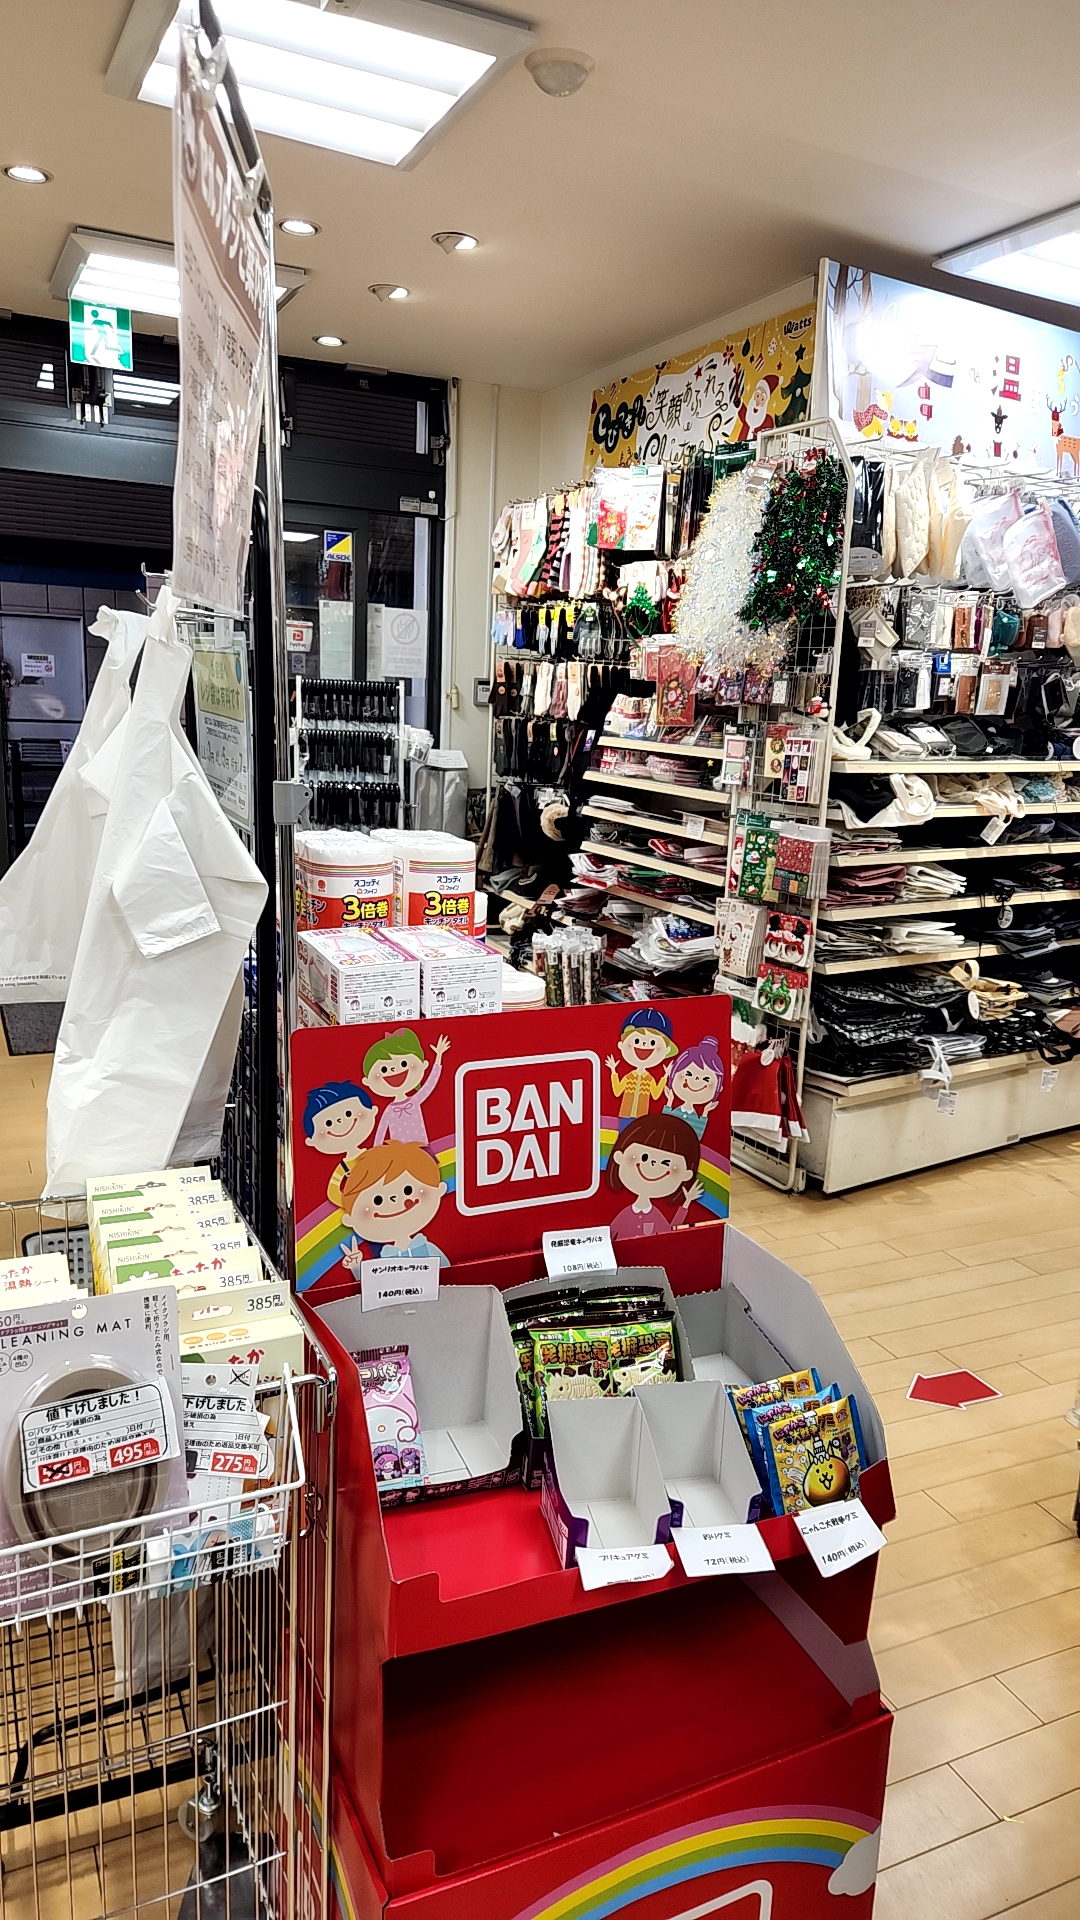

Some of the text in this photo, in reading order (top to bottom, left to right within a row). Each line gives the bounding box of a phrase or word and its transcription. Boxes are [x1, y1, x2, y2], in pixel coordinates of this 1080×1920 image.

[784, 317, 813, 336] Watts
[655, 374, 725, 428] 笑顔あふれる
[200, 683, 240, 711] レジ袋は有料です
[353, 879, 380, 888] スコッティ
[436, 876, 462, 884] スコッティ
[342, 895, 389, 921] 3倍巻
[424, 891, 470, 916] 3倍巻
[424, 916, 469, 926] キッチンタオル
[476, 1079, 583, 1136] BAN
[476, 1131, 560, 1187] DAI
[94, 1184, 123, 1193] NISHIKIN
[101, 1206, 131, 1215] NISHIKIN
[108, 1230, 139, 1239] NISHIKIN
[117, 1254, 150, 1263] NISHIKIN
[561, 1261, 603, 1273] 108円(税込)
[371, 1264, 430, 1275] サンリオキャラパキ
[4, 1278, 59, 1291] 温熱シート
[378, 1287, 423, 1299] 140円(税込)
[247, 1294, 281, 1311] 385円
[1, 1318, 132, 1350] LEANING MAT
[152, 1295, 163, 1375] 軽くて折りたたみ式なので
[540, 1341, 608, 1365] 発掘恐竜
[737, 1383, 770, 1406] にゃんこ
[46, 1391, 140, 1422] 値下げしました！
[757, 1403, 791, 1423] にゃんこ
[774, 1417, 806, 1440] にゃんこ
[113, 1443, 151, 1464] 495円
[213, 1455, 251, 1472] 275円
[800, 1512, 859, 1536] にゃんこ大戦争グミ
[598, 1553, 650, 1561] プリキュアグミ
[703, 1555, 750, 1566] 72円(税込)
[821, 1539, 868, 1566] 140円(税込)
